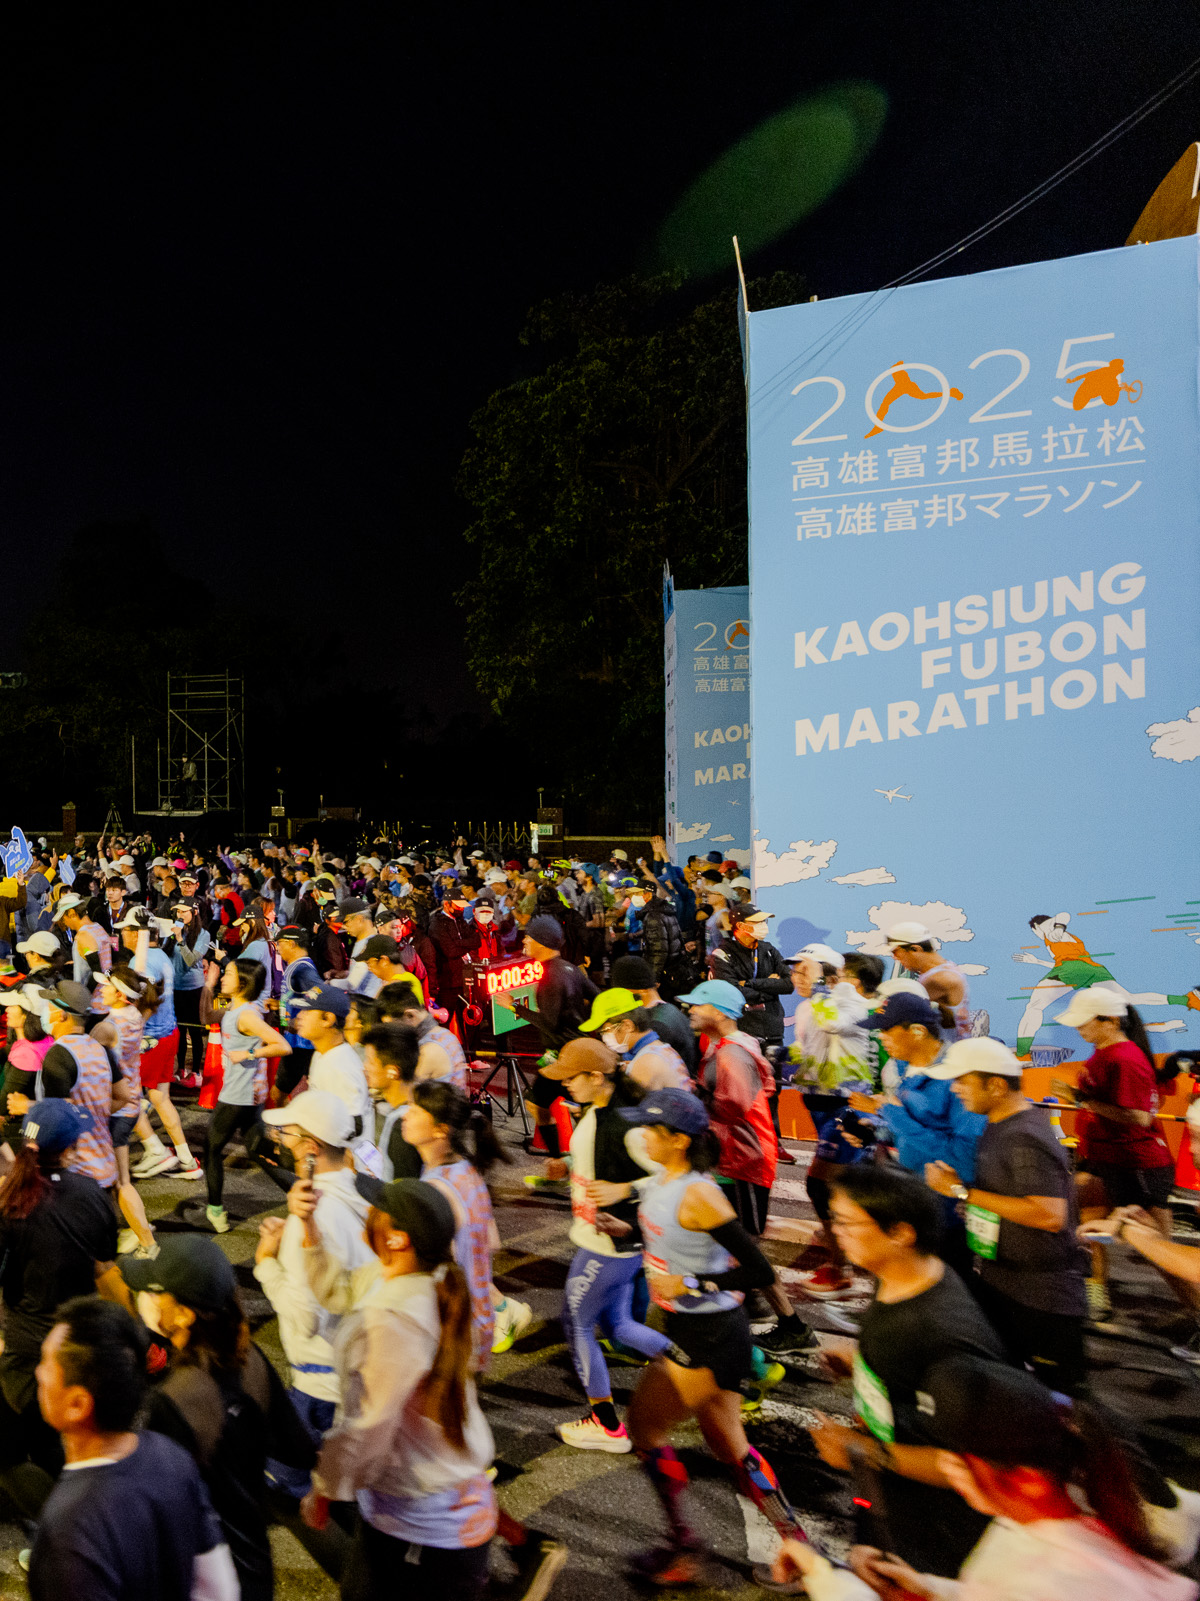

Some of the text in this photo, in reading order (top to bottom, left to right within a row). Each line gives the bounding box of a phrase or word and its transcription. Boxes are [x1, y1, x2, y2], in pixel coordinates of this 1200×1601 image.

[791, 332, 1122, 446] 2025
[791, 417, 1147, 492] 高雄富邦馬拉松
[794, 480, 1143, 541] 高雄富邦マラソン
[794, 562, 1147, 669] KAOHSIUNG
[921, 608, 1147, 690] FUBON
[694, 677, 750, 694] 高雄富
[794, 657, 1147, 758] MARATHON
[694, 763, 751, 787] MAR
[487, 960, 544, 994] 0:00:39
